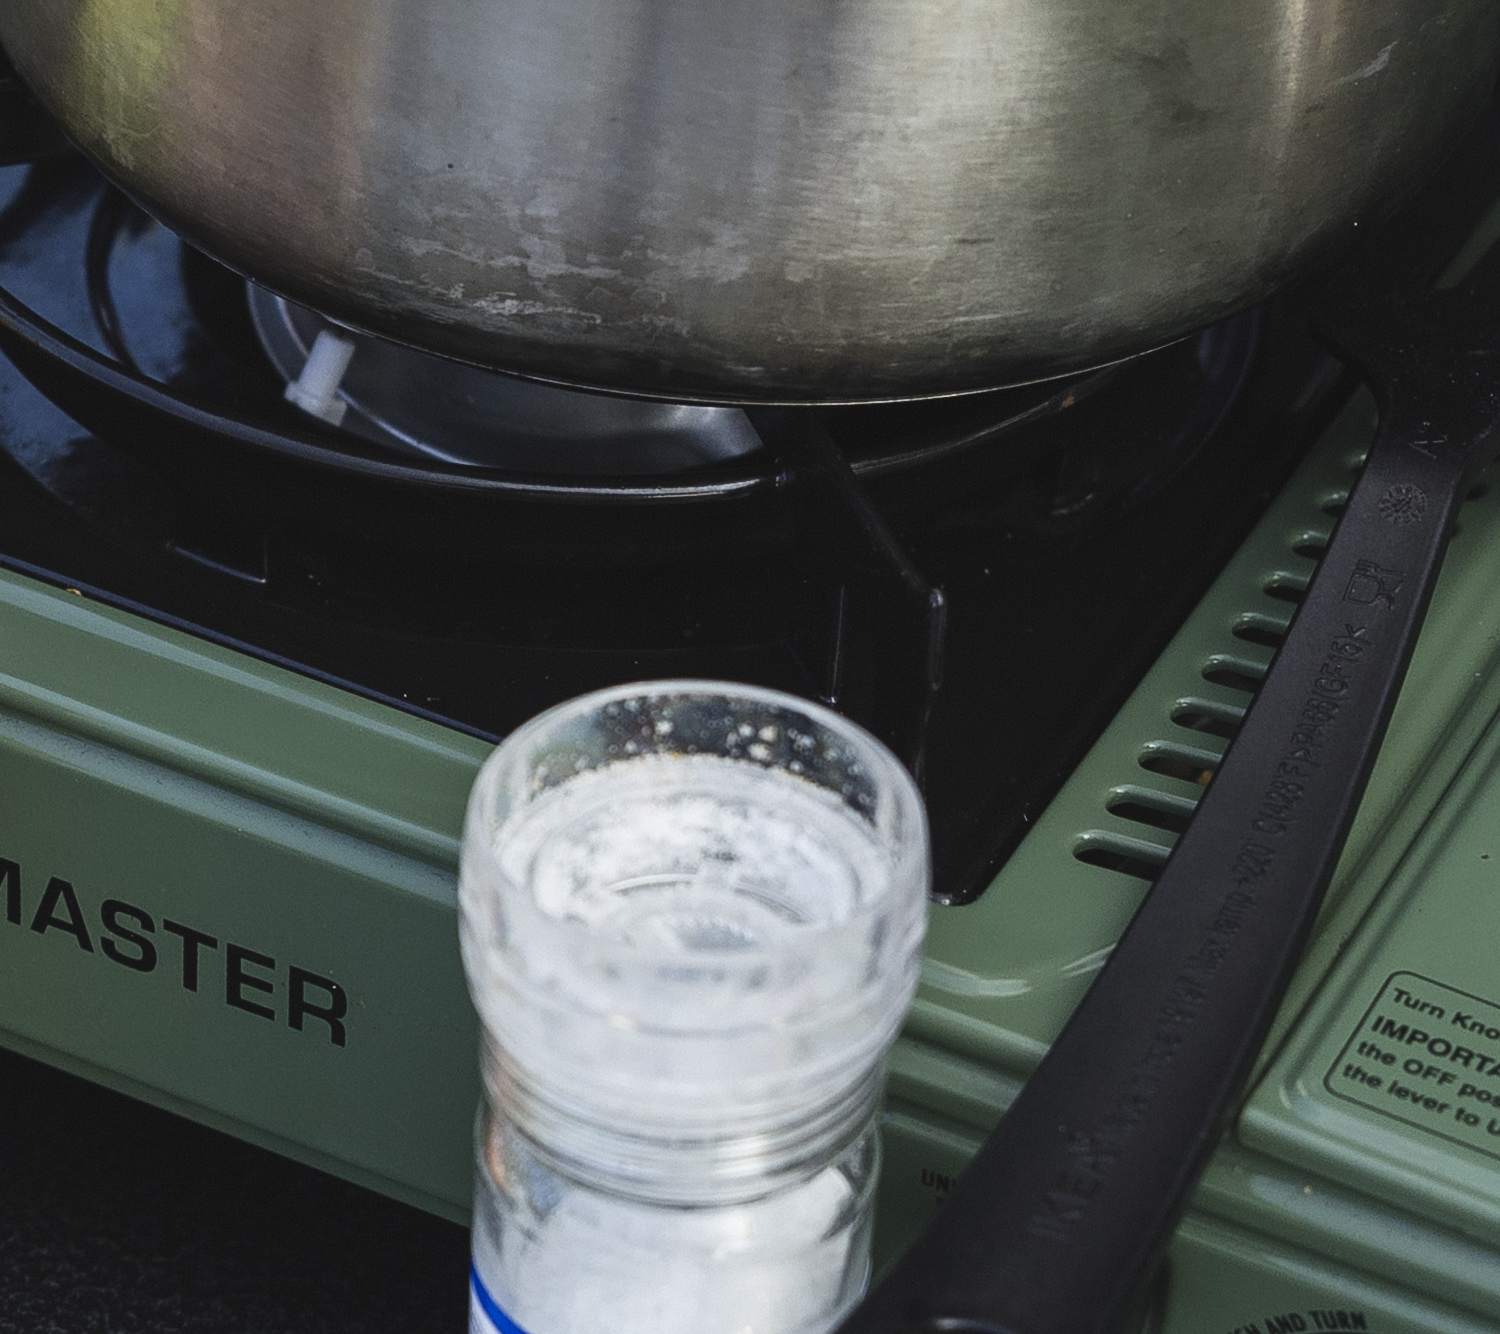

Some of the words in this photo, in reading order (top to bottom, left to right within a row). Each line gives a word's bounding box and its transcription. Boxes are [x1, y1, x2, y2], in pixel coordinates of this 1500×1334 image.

[1393, 987, 1446, 1020] Turn
[1356, 1040, 1397, 1066] the
[1402, 1058, 1457, 1086] OFF
[1342, 1063, 1383, 1089] the
[1387, 1080, 1450, 1114] lever
[1454, 1107, 1481, 1127] to
[1308, 1309, 1367, 1331] TURN
